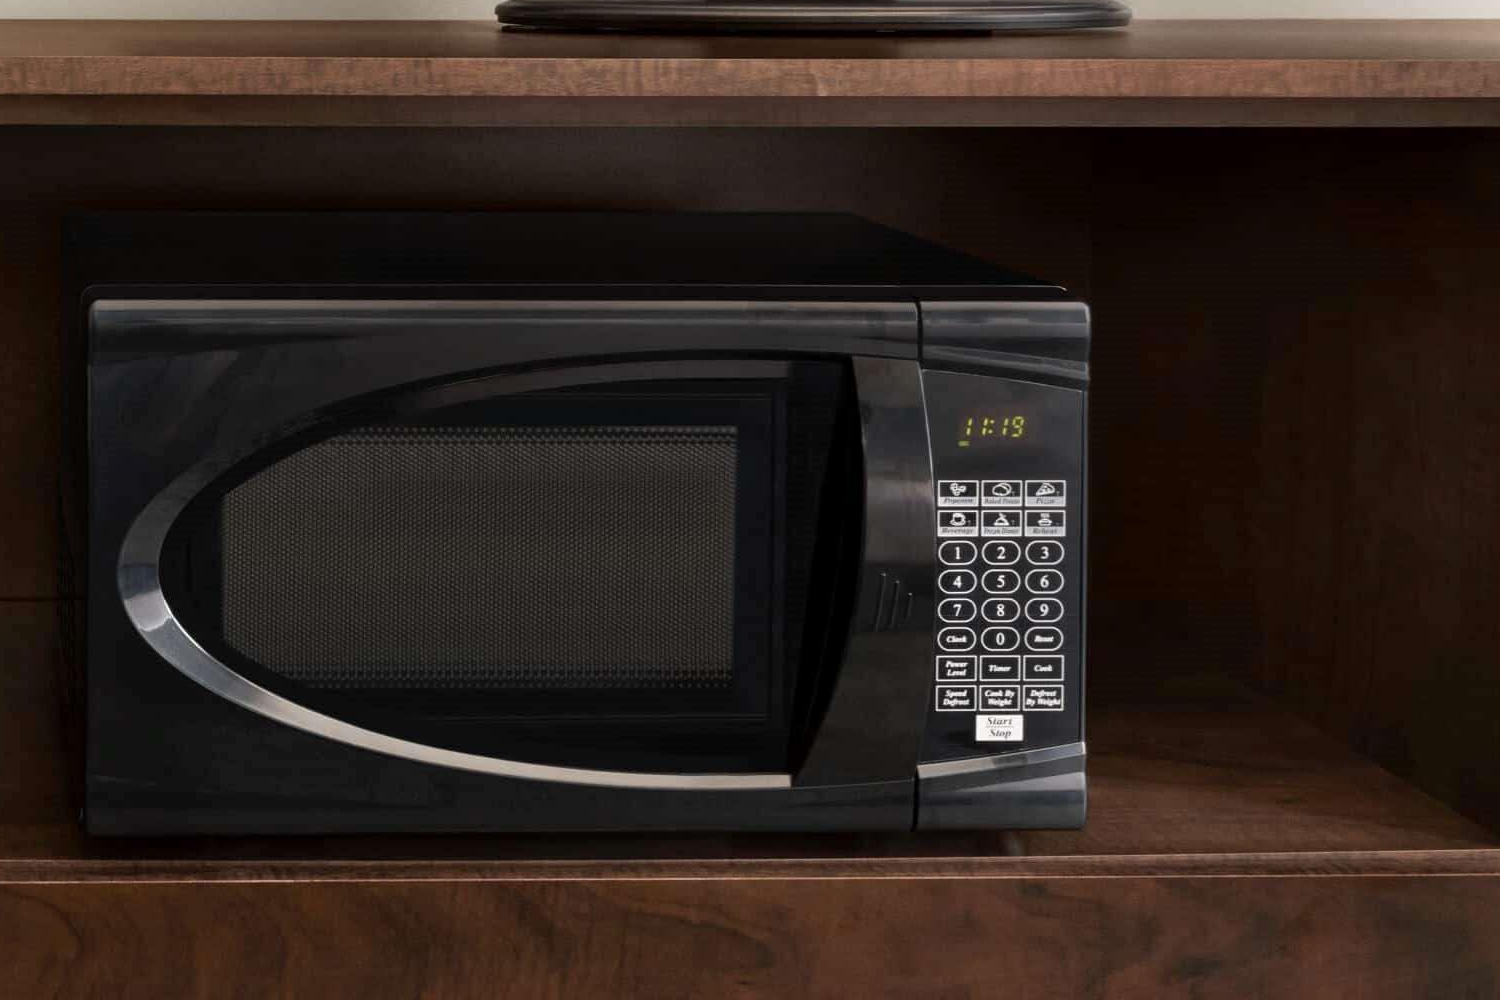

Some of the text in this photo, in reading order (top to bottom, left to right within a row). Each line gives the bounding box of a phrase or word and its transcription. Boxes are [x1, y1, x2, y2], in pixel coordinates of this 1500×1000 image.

[964, 416, 1025, 438] 11:19
[955, 547, 961, 559] 1
[996, 547, 1006, 559] 2
[1040, 547, 1049, 559] 3
[952, 576, 962, 588] 4
[996, 575, 1005, 588] 5
[1040, 575, 1049, 588] 6
[953, 604, 962, 616] 7
[996, 604, 1005, 616] 8
[1040, 604, 1049, 616] 9
[946, 635, 967, 643] Clock
[996, 633, 1005, 645] 0
[945, 661, 968, 669] Power
[947, 669, 966, 677] Level
[945, 690, 967, 699] Speed
[1005, 690, 1015, 699] By
[1030, 690, 1057, 698] Defrost
[943, 698, 969, 707] Defrost
[987, 698, 1012, 707] Weight
[1026, 698, 1061, 707] By Weight
[987, 717, 1013, 726] Start
[989, 729, 1012, 739] Stop
